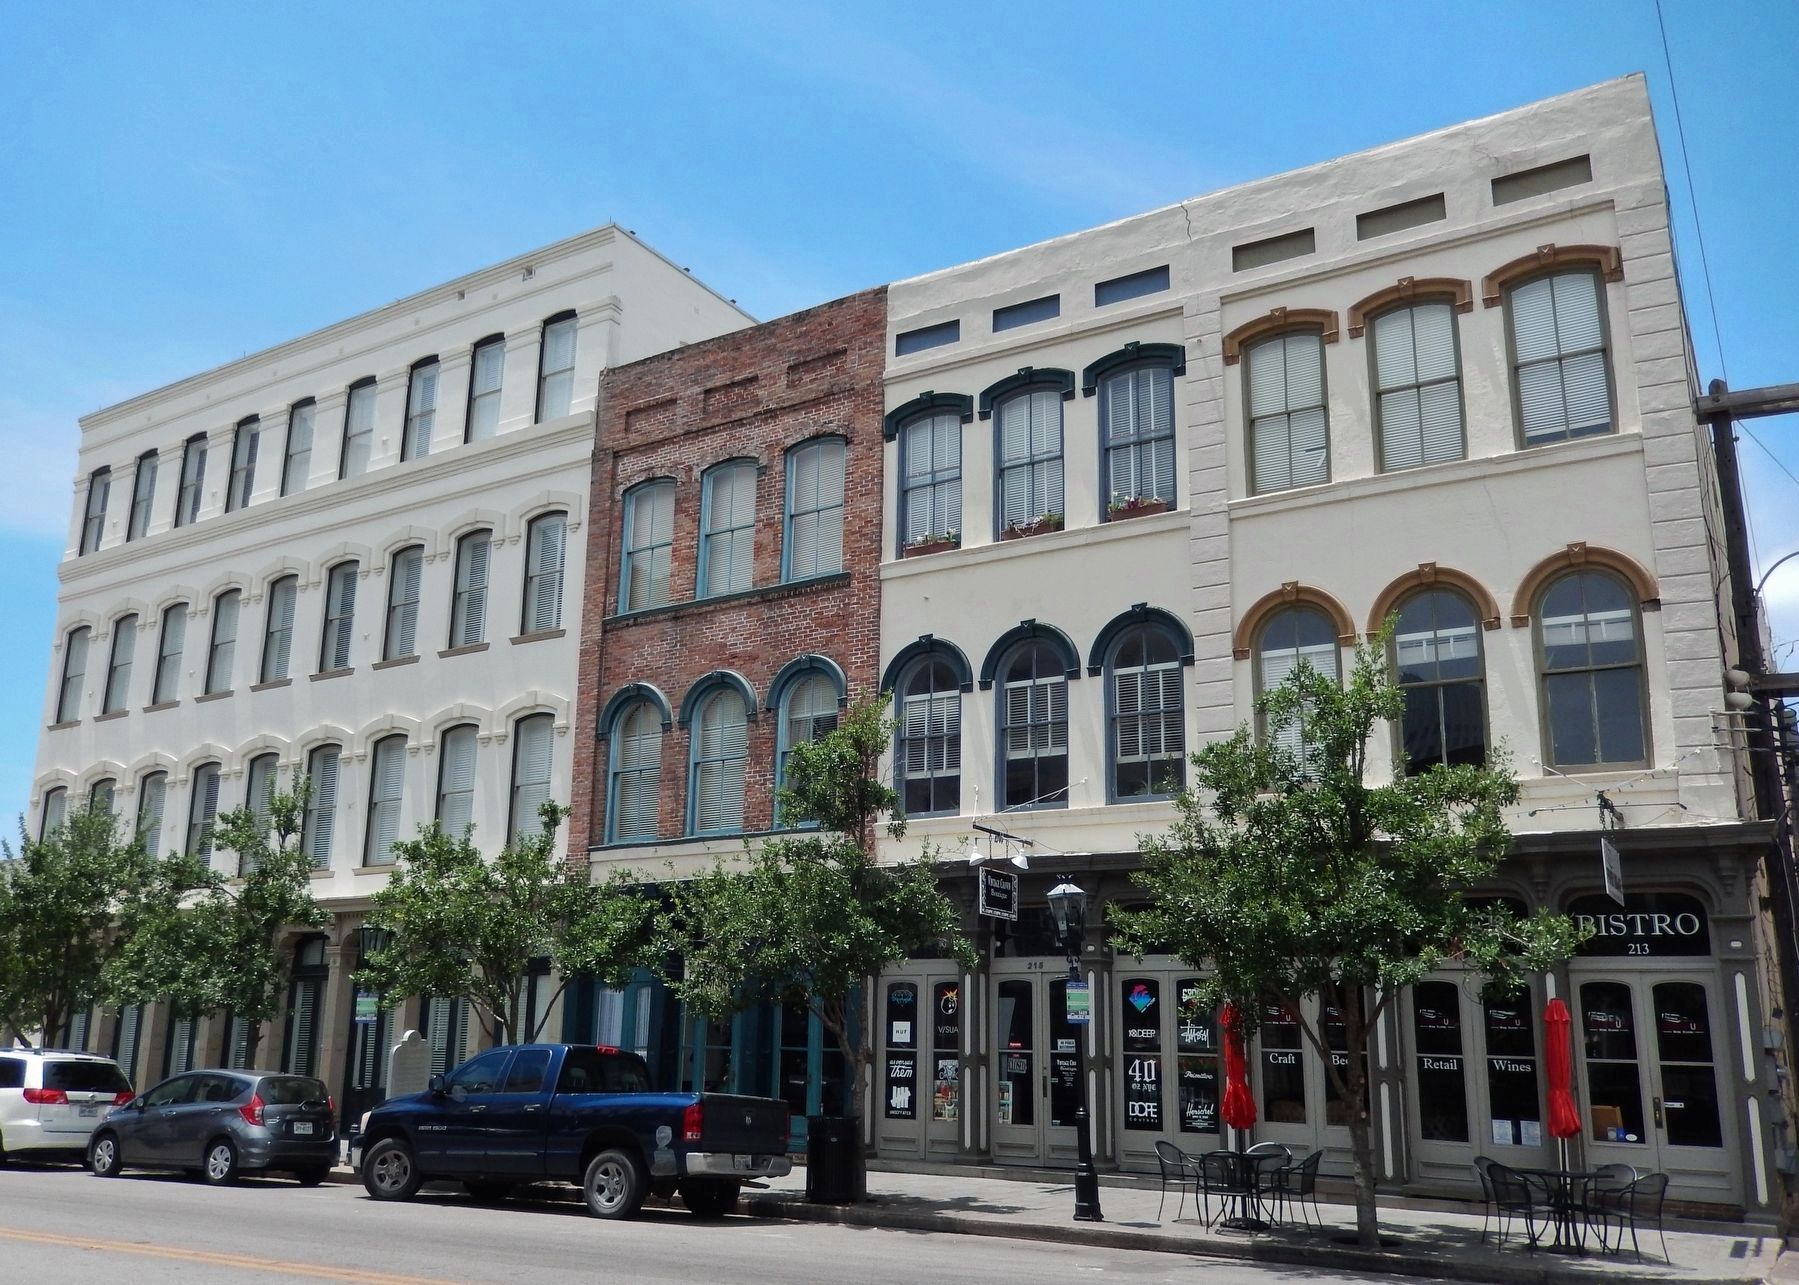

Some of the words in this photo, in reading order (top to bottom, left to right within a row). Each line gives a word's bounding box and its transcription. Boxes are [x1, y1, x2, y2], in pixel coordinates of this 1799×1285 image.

[1575, 912, 1700, 936] BISTRO
[1627, 943, 1650, 955] 213
[938, 1025, 959, 1034] V/SUA
[1269, 1053, 1296, 1064] Craft
[1332, 1055, 1348, 1065] Be
[1423, 1058, 1458, 1070] Retail
[1128, 1058, 1157, 1083] 40
[1493, 1060, 1532, 1072] Wines
[1129, 1101, 1158, 1118] DOPE
[1186, 1102, 1215, 1118] Herschel
